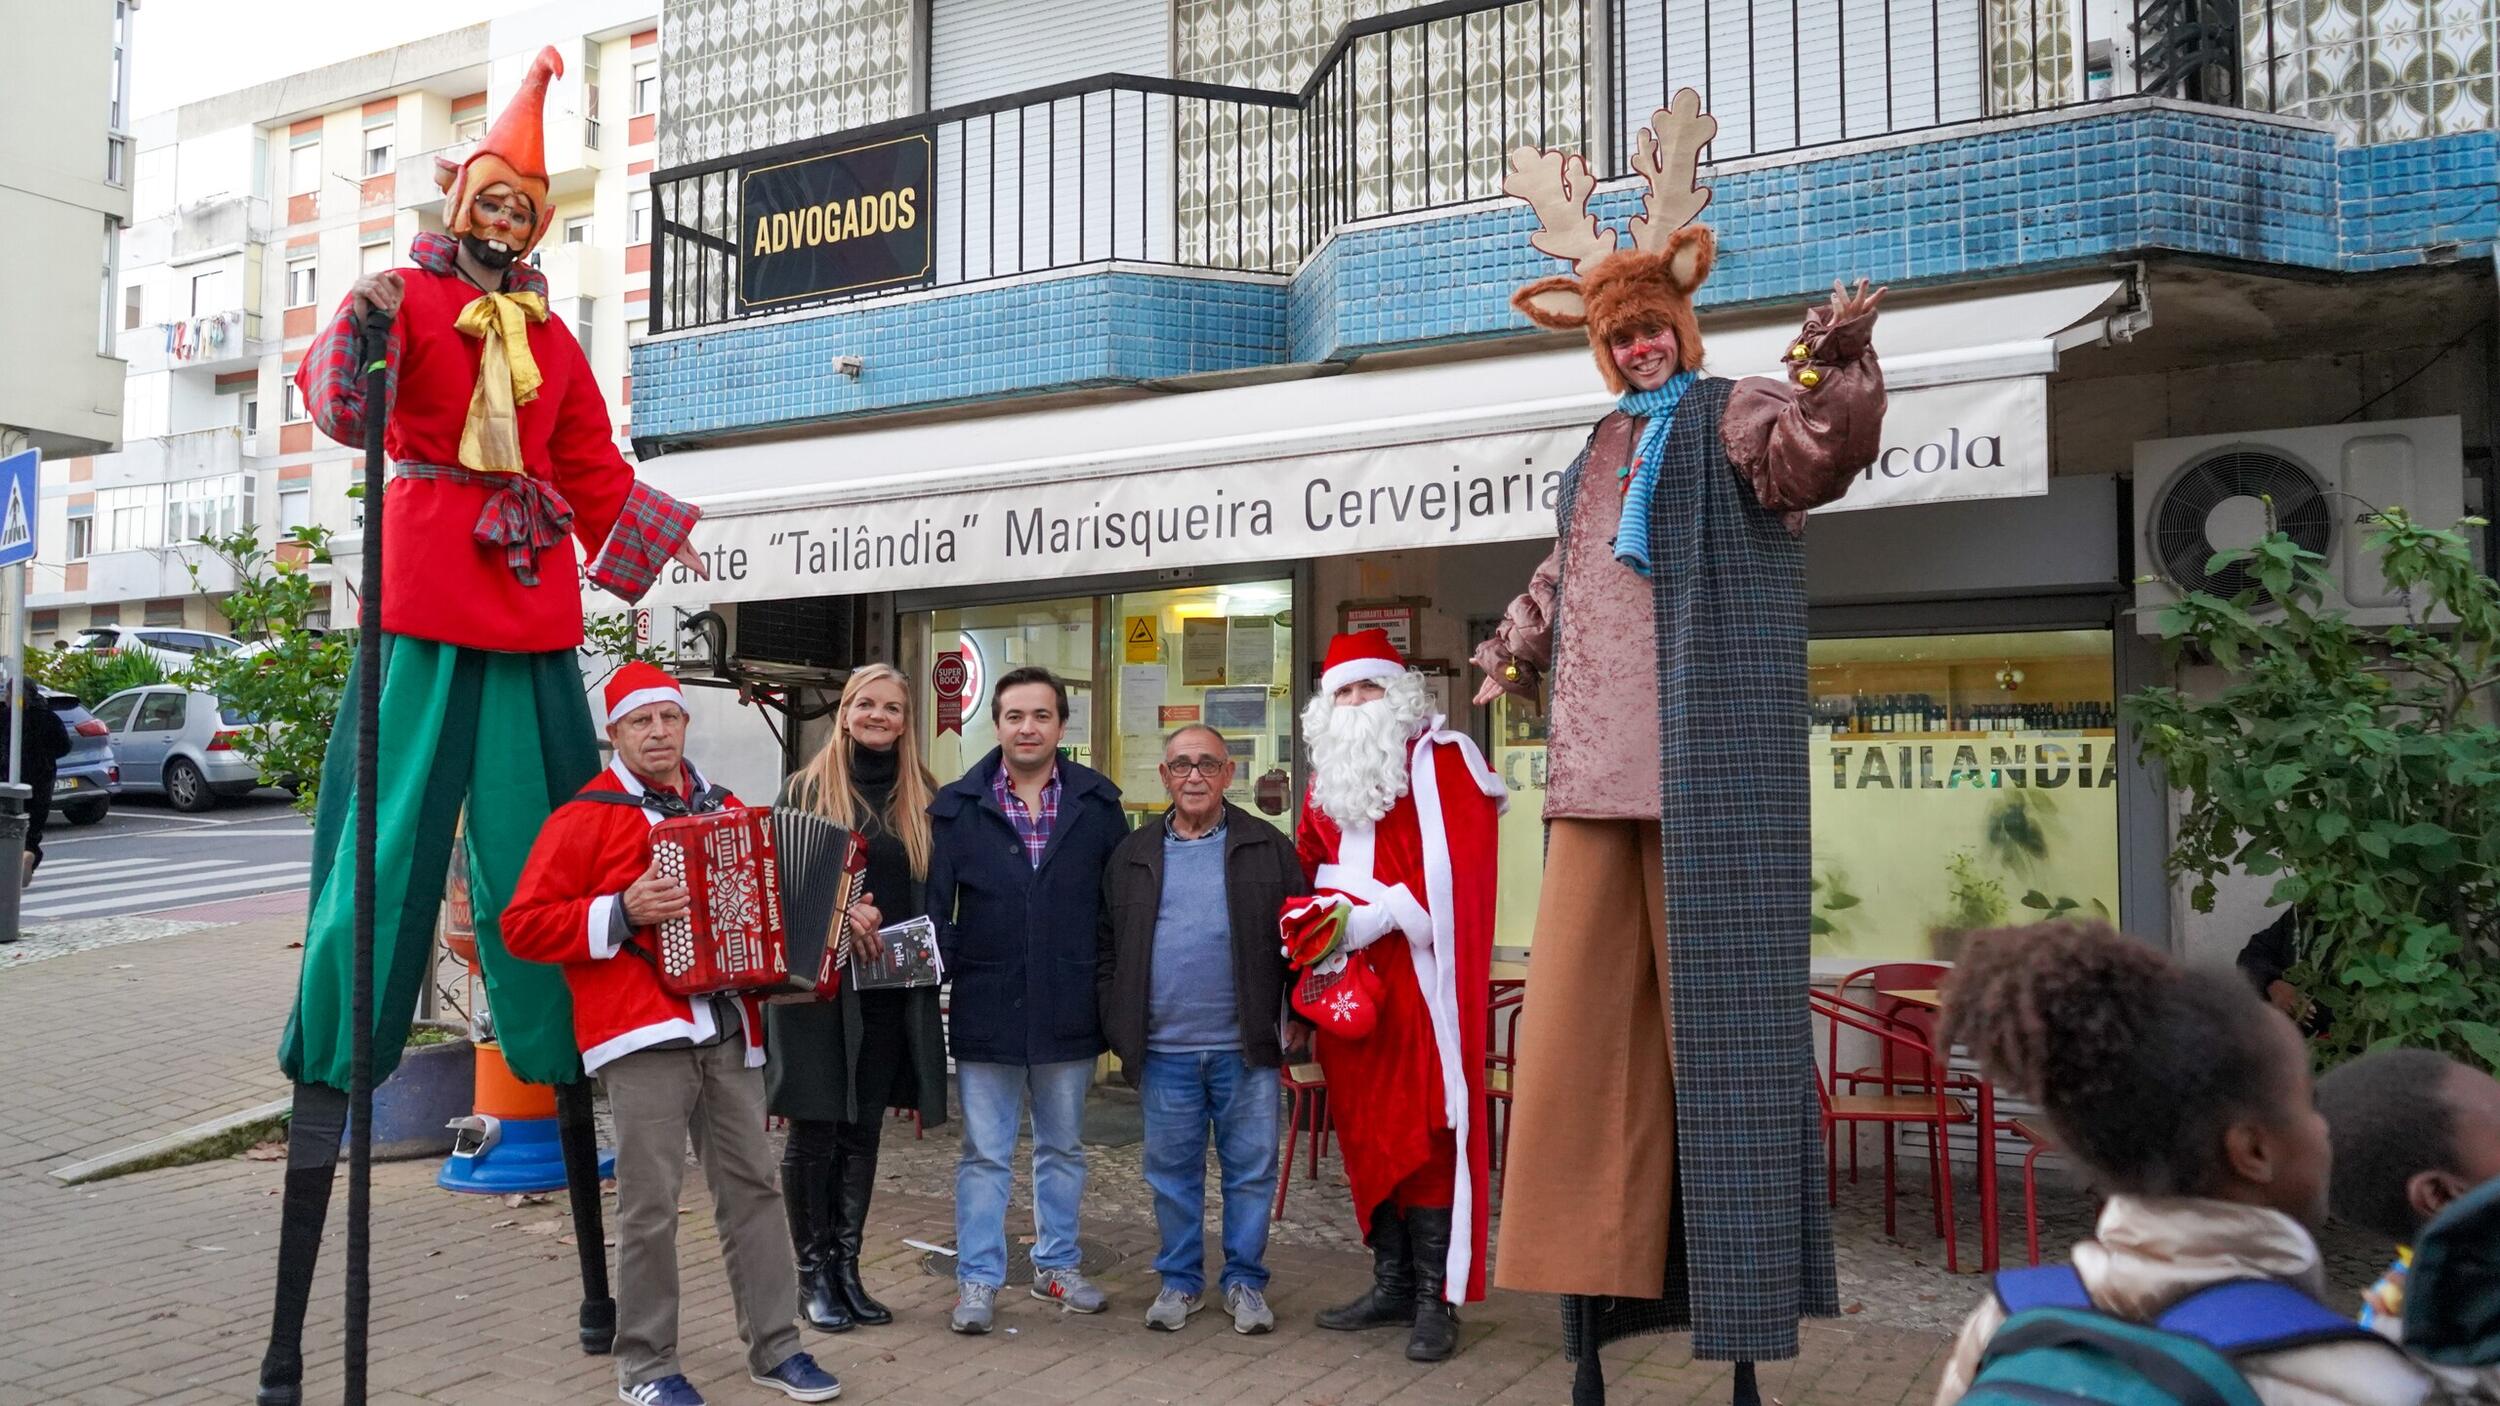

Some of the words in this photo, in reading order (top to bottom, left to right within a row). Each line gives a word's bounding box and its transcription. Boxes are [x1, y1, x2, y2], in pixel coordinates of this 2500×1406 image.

[754, 187, 916, 257] ADVOGADOS
[1005, 489, 1273, 557] Marisqueira
[1304, 457, 1565, 532] Cervejaria
[1865, 427, 2006, 481] cola
[938, 667, 962, 677] SUPER
[939, 676, 960, 685] BOCK
[763, 857, 782, 932] MANFRINI
[893, 942, 905, 968] Feliz
